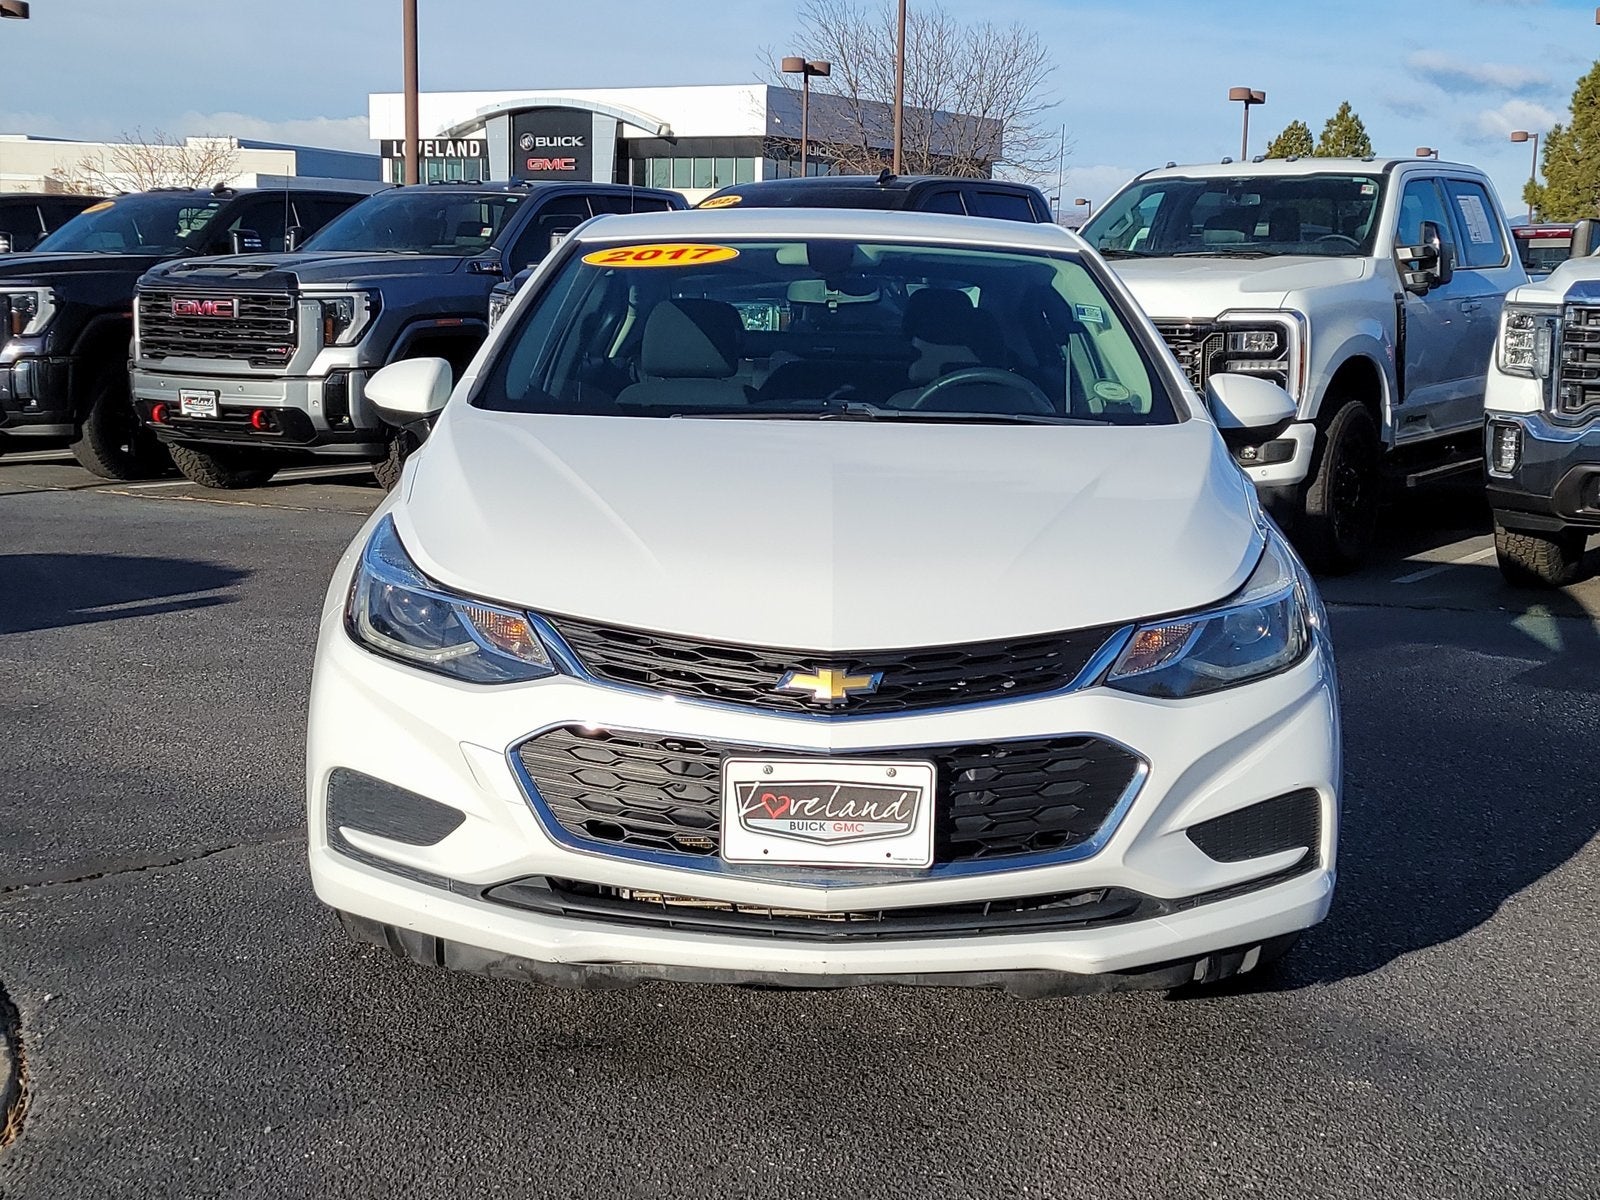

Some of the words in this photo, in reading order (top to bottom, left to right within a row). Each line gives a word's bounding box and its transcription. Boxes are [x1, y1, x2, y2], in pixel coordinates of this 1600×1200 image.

[535, 136, 584, 147] BUICK
[527, 158, 576, 171] GMC
[598, 247, 723, 262] 2017
[175, 299, 233, 317] GMC
[789, 821, 826, 832] BUICK
[832, 822, 865, 833] GMC
